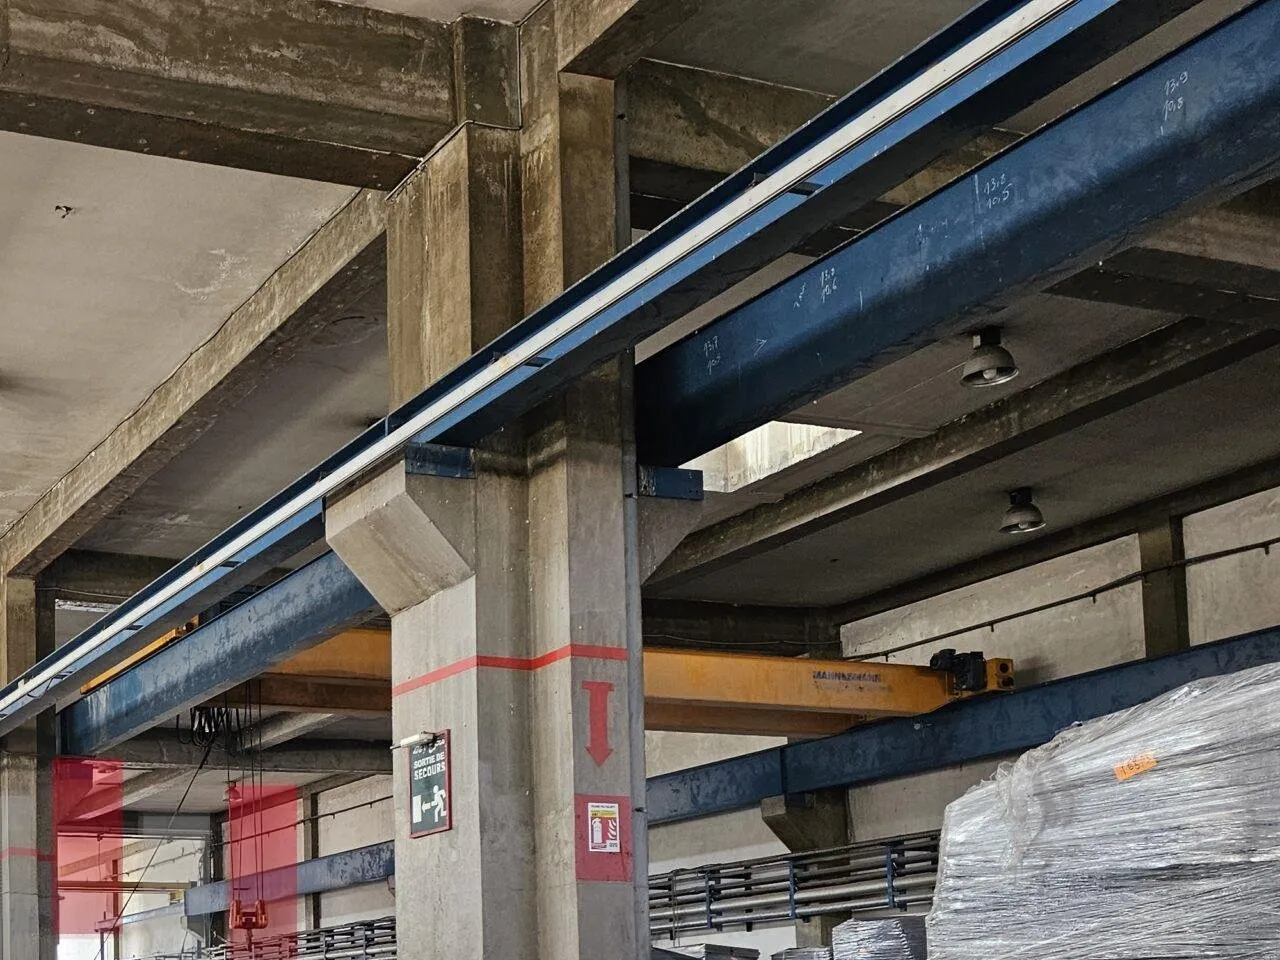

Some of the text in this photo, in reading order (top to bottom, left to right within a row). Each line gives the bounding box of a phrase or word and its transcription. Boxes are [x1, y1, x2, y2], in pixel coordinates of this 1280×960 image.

[413, 751, 446, 769] SORTIE DE
[414, 761, 446, 781] SECOURS
